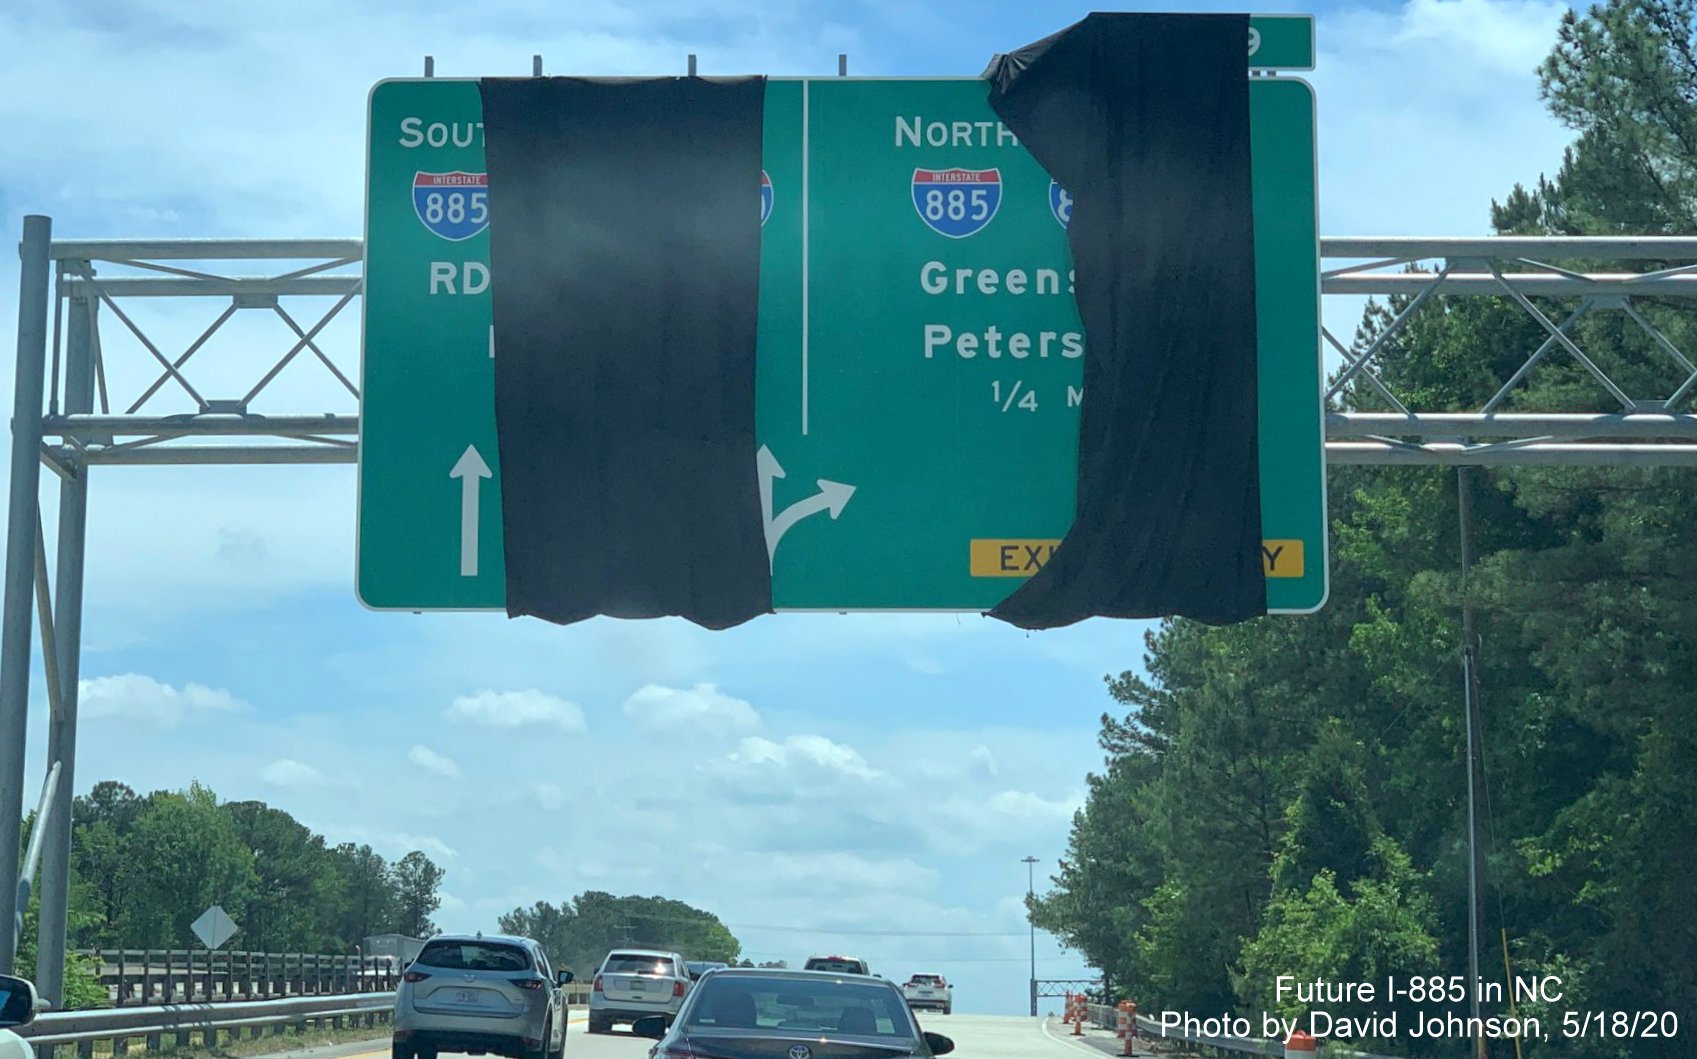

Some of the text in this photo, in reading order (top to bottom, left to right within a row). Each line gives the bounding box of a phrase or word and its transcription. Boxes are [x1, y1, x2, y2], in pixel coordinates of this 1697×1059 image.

[433, 175, 481, 185] INTERSTATE
[932, 172, 981, 182] INTERSTATE
[426, 192, 488, 224] 885
[925, 189, 988, 221] 885
[429, 261, 490, 295] RD
[924, 324, 1084, 359] Peters
[991, 380, 1038, 412] 1/4
